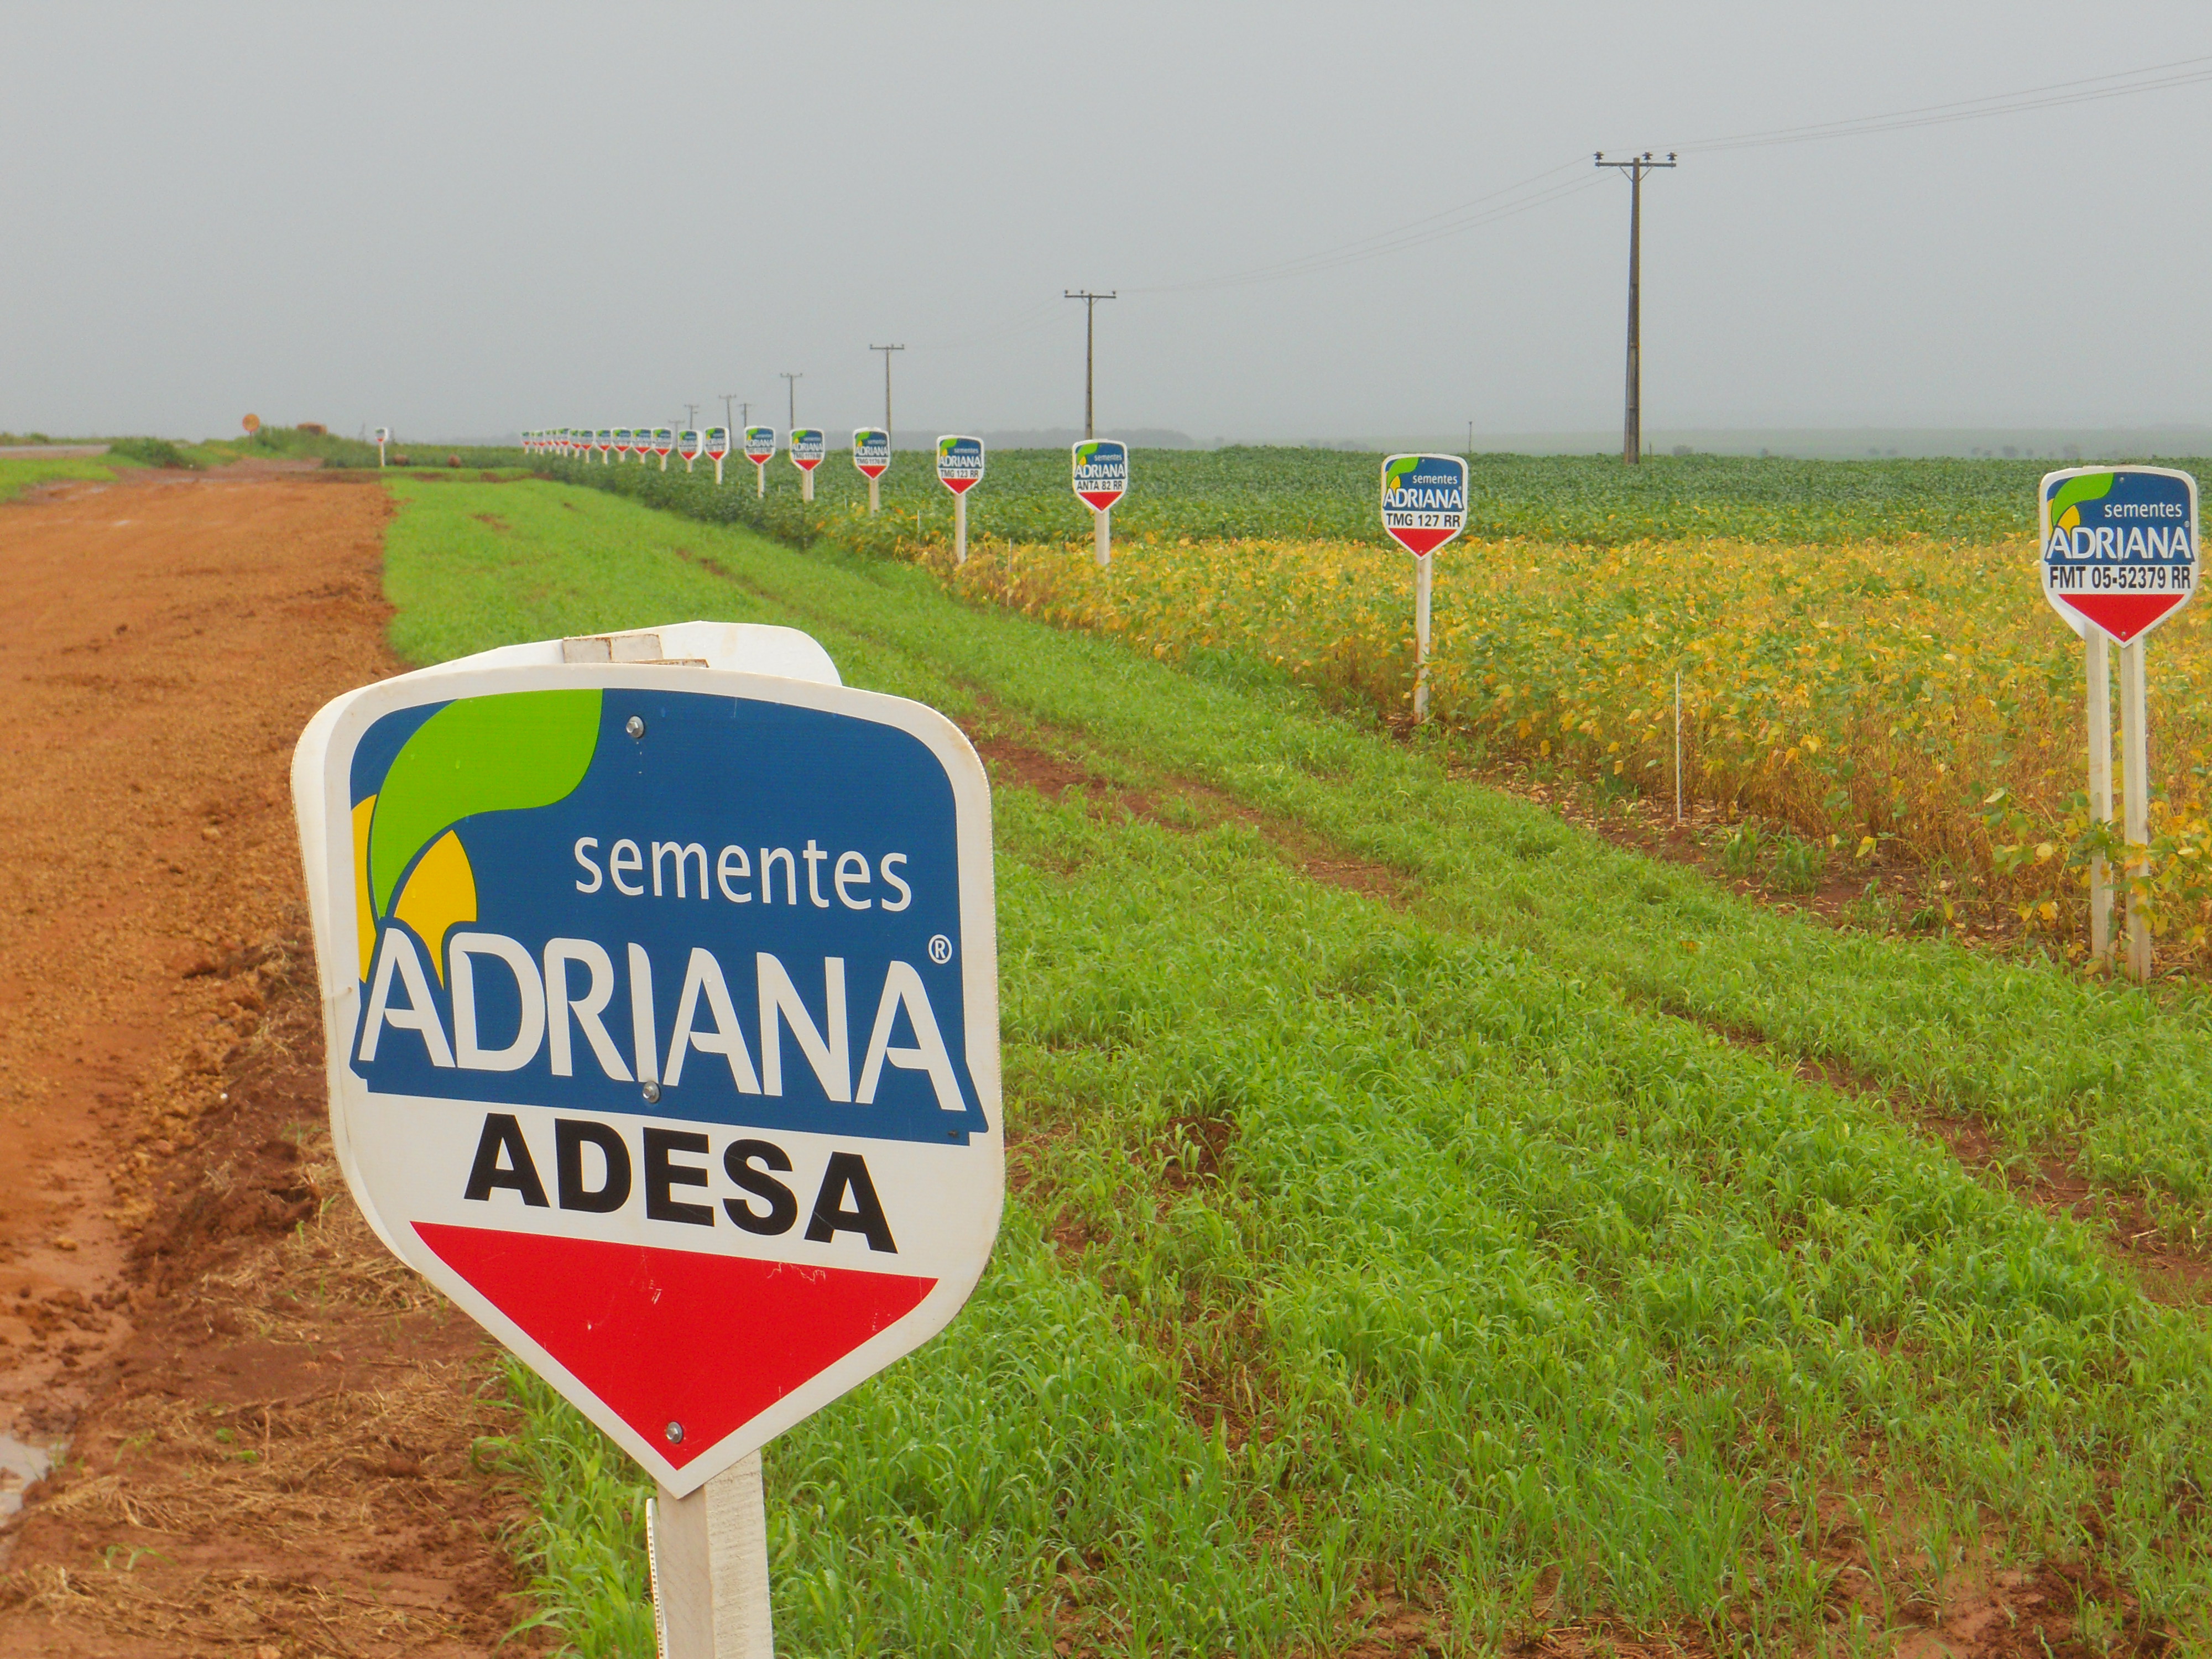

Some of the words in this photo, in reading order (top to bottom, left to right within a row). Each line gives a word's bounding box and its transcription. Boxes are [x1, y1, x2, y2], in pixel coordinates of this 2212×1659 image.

[855, 446, 888, 456] ADRIANA
[938, 455, 982, 467] ADRIANA
[941, 469, 954, 477] TMG
[957, 469, 968, 478] 123
[970, 469, 979, 478] RR
[1074, 464, 1125, 478] ADRIANA
[1077, 481, 1099, 490] ANTA
[1102, 481, 1111, 490] 82
[1113, 481, 1123, 490] RR
[1412, 474, 1458, 484] sementes
[1384, 488, 1463, 509] ADRIANA
[2104, 502, 2182, 518] sementes
[1386, 513, 1413, 526] TMG
[1417, 514, 1439, 527] 127
[1444, 514, 1460, 528] RR
[2049, 566, 2086, 589] FMT
[2091, 566, 2166, 589] 05-52379
[2171, 566, 2191, 589] RR
[575, 836, 912, 912] sementes
[463, 1113, 899, 1254] ADESA
